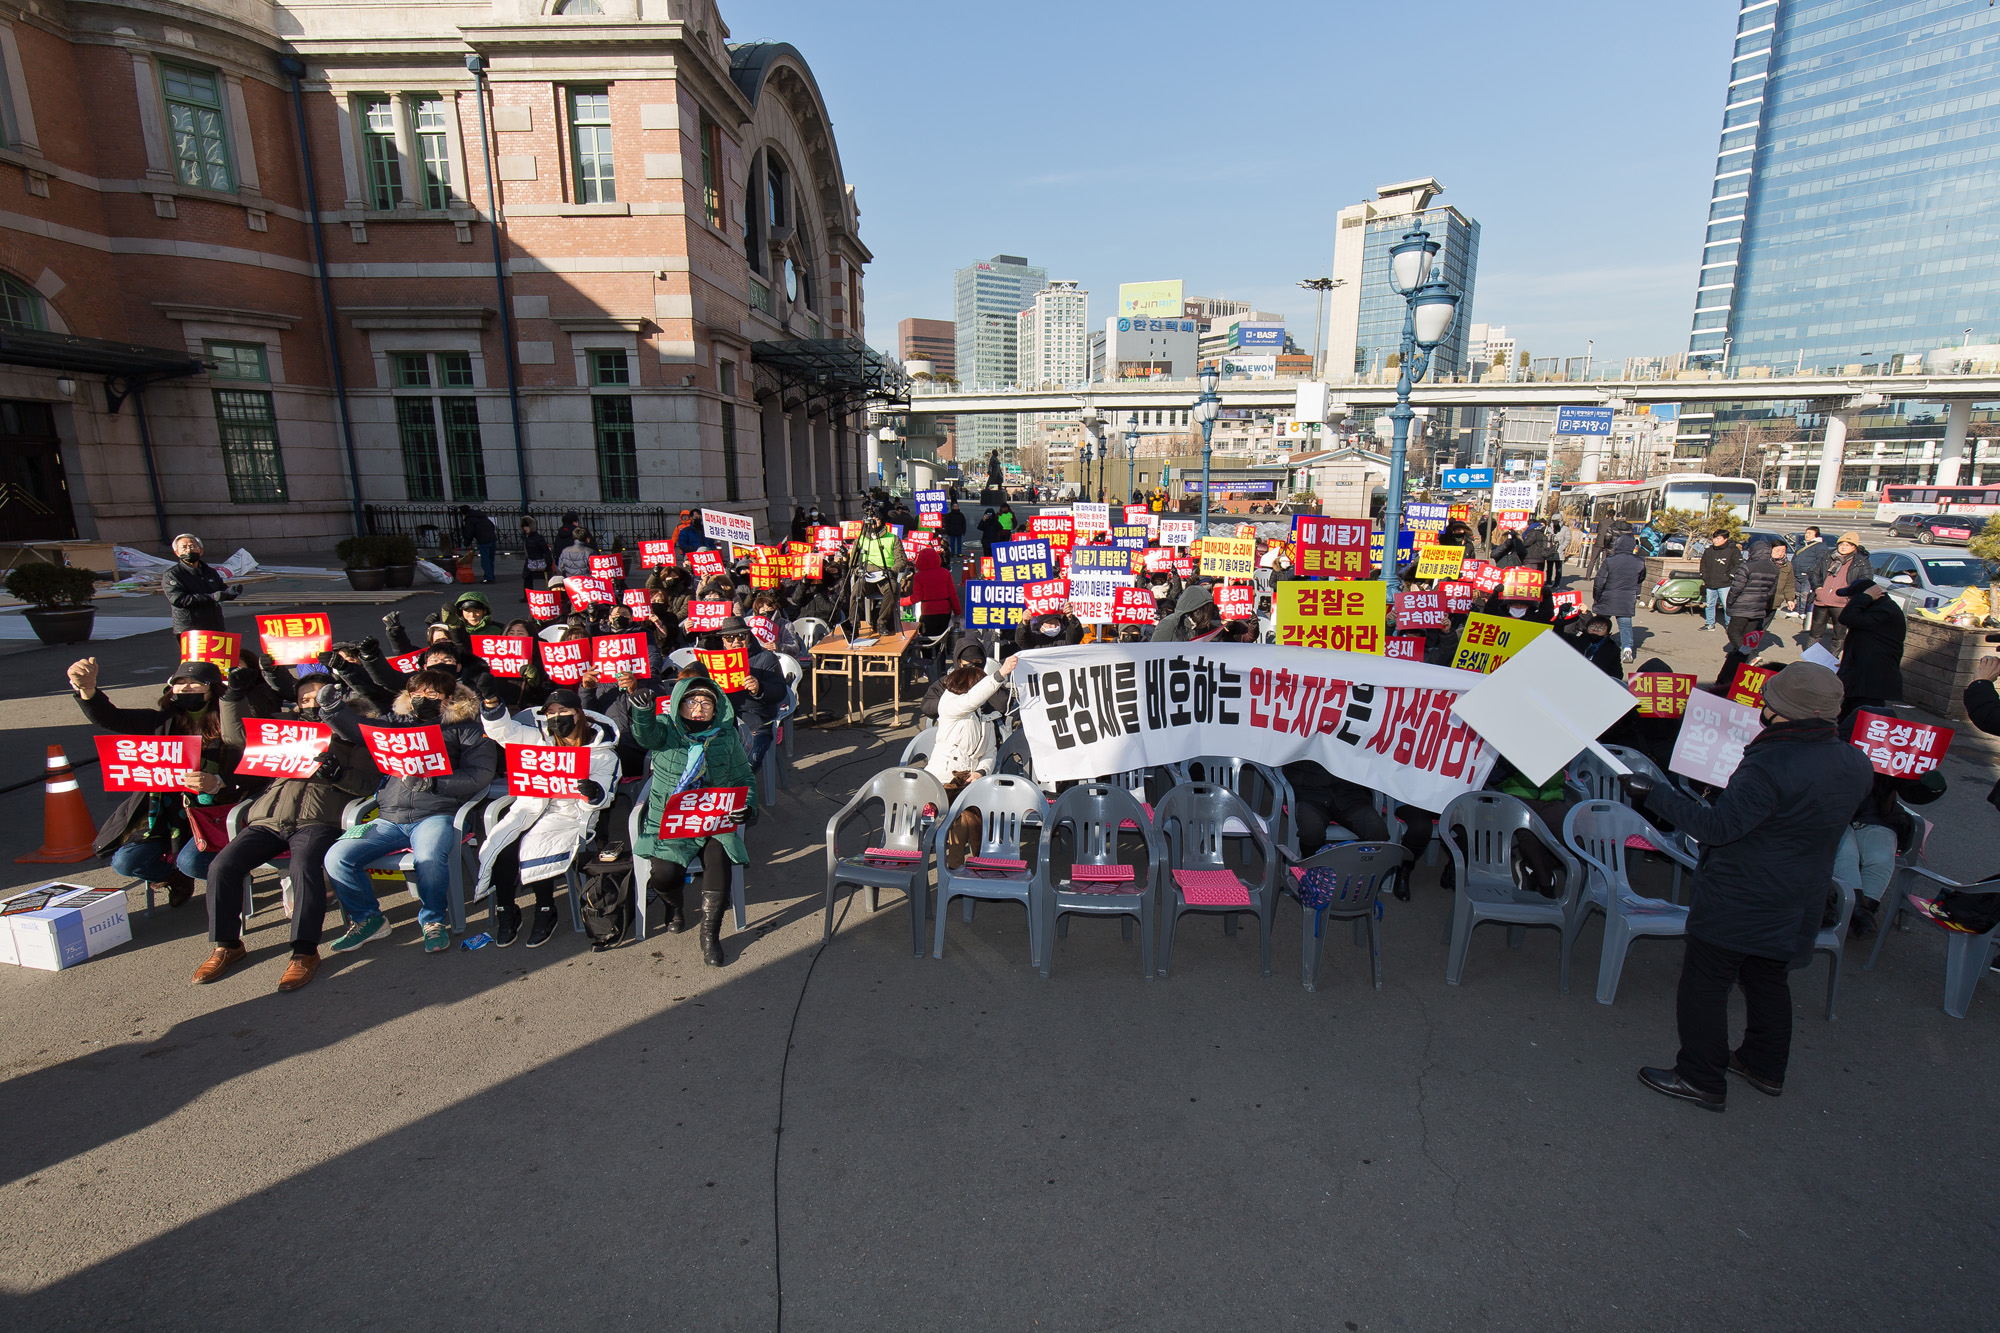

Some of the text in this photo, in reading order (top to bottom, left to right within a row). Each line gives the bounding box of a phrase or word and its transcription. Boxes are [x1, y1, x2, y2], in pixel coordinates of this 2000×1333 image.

[1133, 319, 1194, 333] 한진택배
[1572, 420, 1600, 432] 주차장
[704, 512, 752, 531] 피해자를 외면하는
[1162, 522, 1180, 532] 채굴기
[1181, 522, 1193, 532] 도둑
[1406, 518, 1446, 532] 구속수사하라
[708, 525, 750, 542] 검찰은 각성하라
[818, 528, 839, 539] 윤성재
[1113, 526, 1128, 538] 채굴기
[1128, 526, 1147, 537] 불법점유
[1167, 534, 1187, 544] 윤성재
[1302, 523, 1366, 547] 내 채굴기
[645, 542, 669, 554] 윤성재
[790, 542, 812, 553] 채굴기
[815, 540, 842, 551] 구속하라
[1116, 538, 1144, 549] 처벌하라
[1203, 541, 1231, 555] 피해자의
[1232, 543, 1253, 557] 소리에
[643, 553, 674, 566] 구속하라
[692, 553, 716, 564] 윤성재
[794, 555, 820, 566] 채굴기
[996, 543, 1047, 564] 내 이더리움
[1075, 549, 1097, 567] 채굴기
[1099, 549, 1128, 567] 불법점유
[1303, 549, 1363, 572] 돌려줘
[1422, 549, 1446, 561] 4차산업의
[593, 556, 618, 569] 윤성재
[693, 562, 723, 575] 구속하라
[752, 564, 779, 577] 채굴기
[1203, 557, 1252, 573] 귀를 기울여달라
[1419, 563, 1439, 575] 채굴기를
[1439, 564, 1459, 575] 돌려달라
[591, 567, 623, 580] 구속하라
[1000, 562, 1048, 582] 돌려줘
[1483, 566, 1502, 580] 윤성
[1503, 571, 1542, 585] 채굴기
[572, 578, 606, 592] 윤성재
[752, 577, 779, 588] 돌려줘
[1031, 581, 1065, 598] 윤성재
[1091, 580, 1110, 597] 마음대로
[529, 592, 555, 604] 윤성재
[971, 585, 1025, 604] 내 이더리움
[1122, 590, 1153, 606] 윤성재
[1220, 588, 1249, 602] 윤성재
[1444, 584, 1471, 598] 윤성재
[1503, 585, 1542, 598] 돌려줘
[571, 591, 614, 608] 구속하라
[1297, 588, 1365, 617] 검찰은
[1403, 594, 1439, 609] 윤성재
[1447, 599, 1473, 611] 속하라
[530, 605, 560, 618] 구속하라
[695, 603, 725, 616] 윤성재
[972, 606, 1023, 625] 돌려줘
[1115, 606, 1157, 621] 구속하라
[1399, 611, 1445, 626] 구속하라
[264, 617, 325, 639] 채굴기
[1466, 620, 1511, 648] 검찰이
[1282, 624, 1379, 653] 각성하라
[482, 638, 522, 656] 윤성재
[544, 643, 582, 663] 윤성재
[598, 637, 637, 658] 윤성재
[1384, 640, 1415, 657] 성재
[545, 660, 592, 681] 구속하라
[709, 671, 745, 690] 려줘
[1634, 676, 1691, 696] 채굴기
[1145, 654, 1241, 731] 비호하는
[1249, 666, 1375, 746] 인천지검은
[260, 723, 318, 746] 윤성재
[372, 731, 430, 753] 윤성재
[1866, 720, 1937, 753] 윤성재
[116, 740, 184, 764] 윤성재
[374, 752, 446, 776] 구속하라
[520, 748, 576, 774] 윤성재
[109, 766, 194, 788] 구속하라
[679, 793, 736, 813] 윤성재
